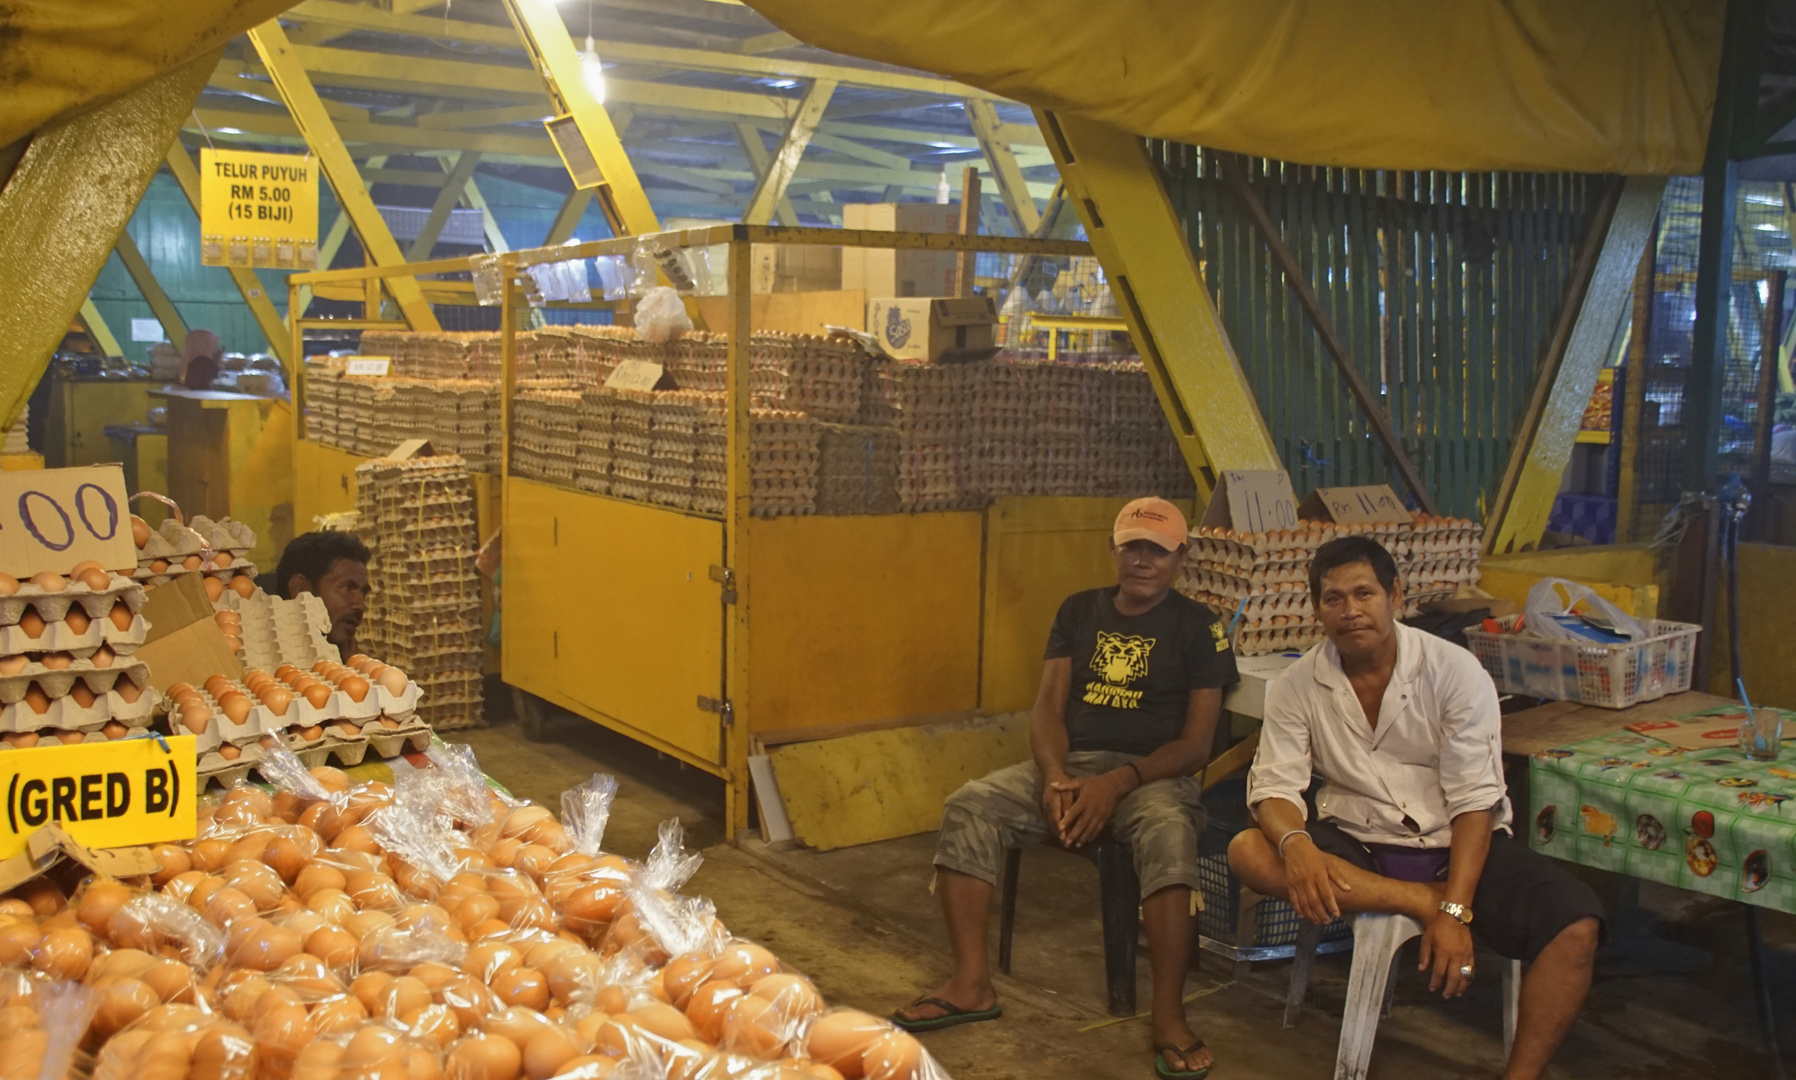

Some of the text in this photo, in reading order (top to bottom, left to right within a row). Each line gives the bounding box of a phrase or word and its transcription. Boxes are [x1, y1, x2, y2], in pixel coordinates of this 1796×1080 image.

[214, 162, 307, 183] TELUR PUYUH
[231, 184, 291, 203] RM 5.00
[228, 202, 294, 225] (15 BIJI)
[1244, 489, 1296, 535] 11.00
[7, 759, 180, 834] (GRED B)
